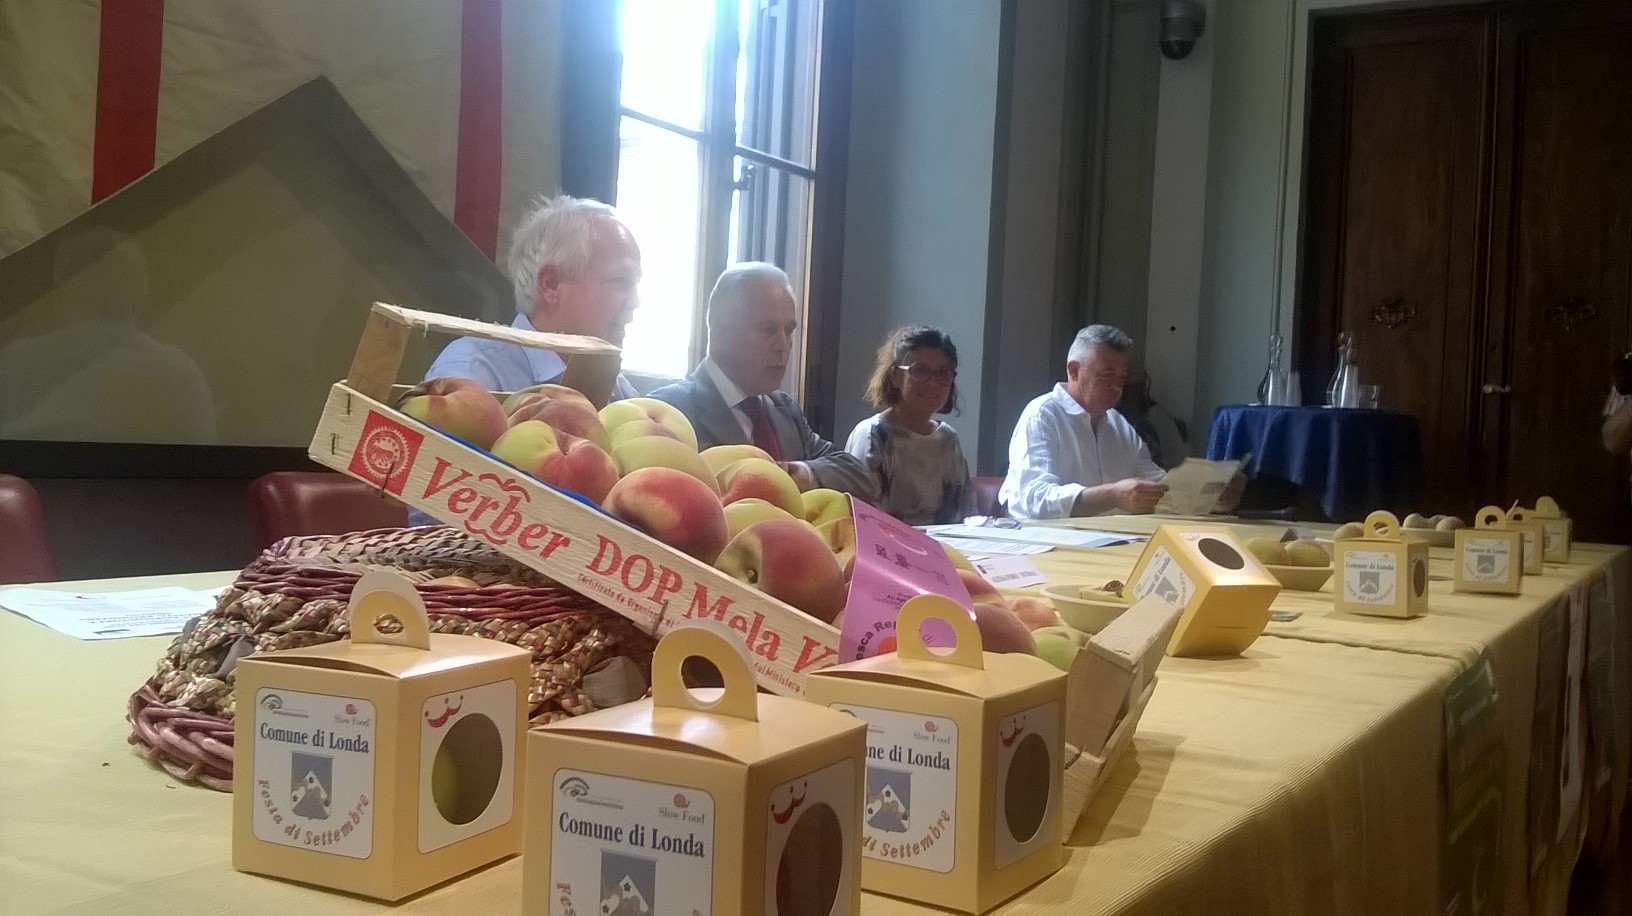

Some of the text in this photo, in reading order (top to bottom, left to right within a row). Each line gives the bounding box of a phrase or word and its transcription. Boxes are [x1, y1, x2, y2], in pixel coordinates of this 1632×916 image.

[421, 456, 571, 559] Verber
[585, 534, 683, 606] DOP
[682, 581, 781, 662] Mela
[627, 597, 664, 622] Organism
[856, 631, 873, 660] esca
[260, 722, 370, 753] Comune di Londa
[865, 745, 950, 770] ne di Londa
[258, 780, 370, 846] Festa di Settembre
[658, 807, 707, 824] Slow Food
[559, 812, 705, 858] Comune di Londa
[881, 809, 950, 858] Settembre
